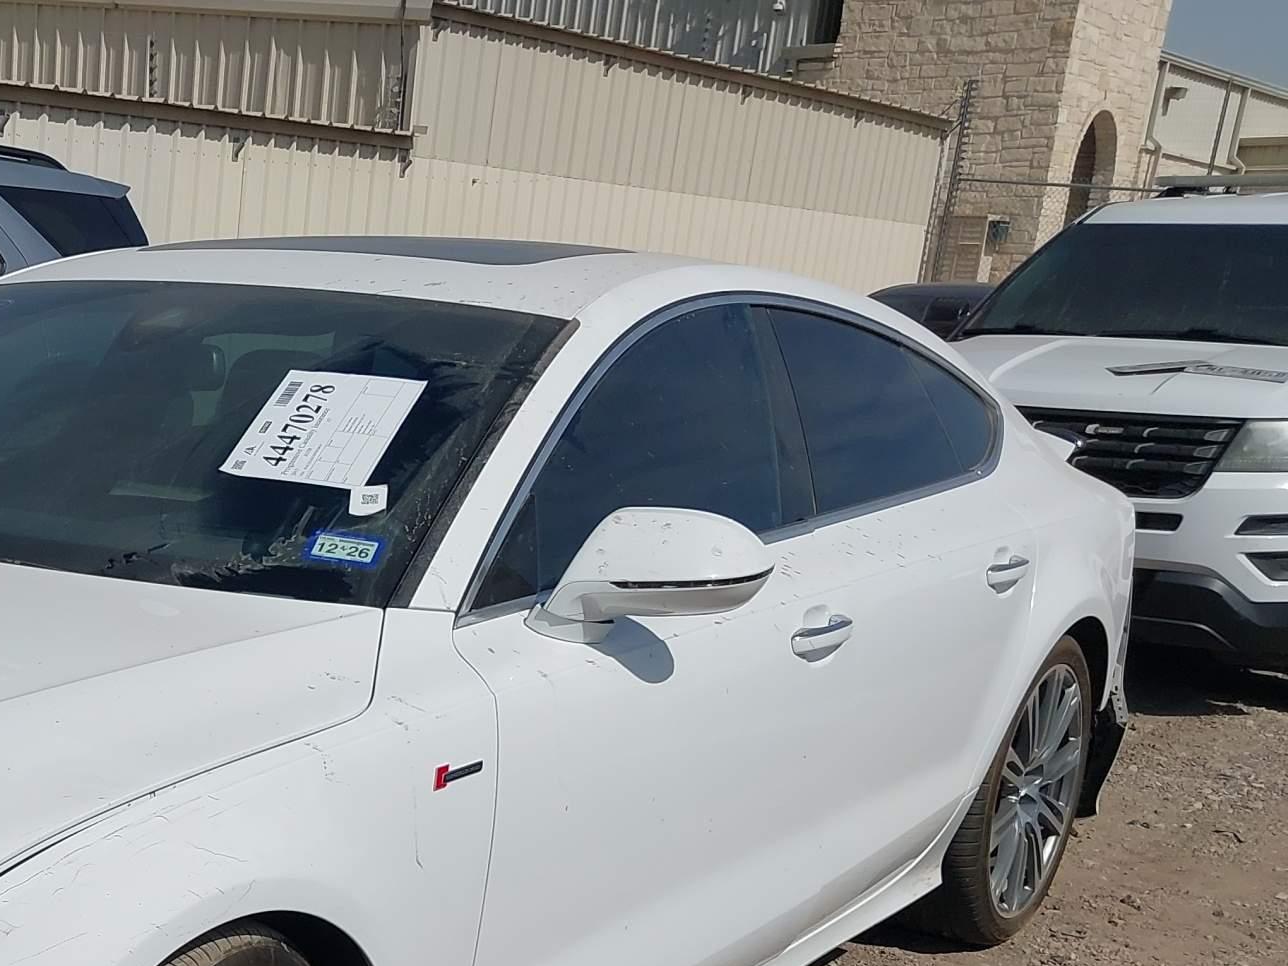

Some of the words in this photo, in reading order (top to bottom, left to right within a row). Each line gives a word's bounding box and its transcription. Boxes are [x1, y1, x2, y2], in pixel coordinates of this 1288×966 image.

[263, 384, 336, 469] 44470278
[317, 542, 339, 554] 12
[346, 545, 371, 559] 26
